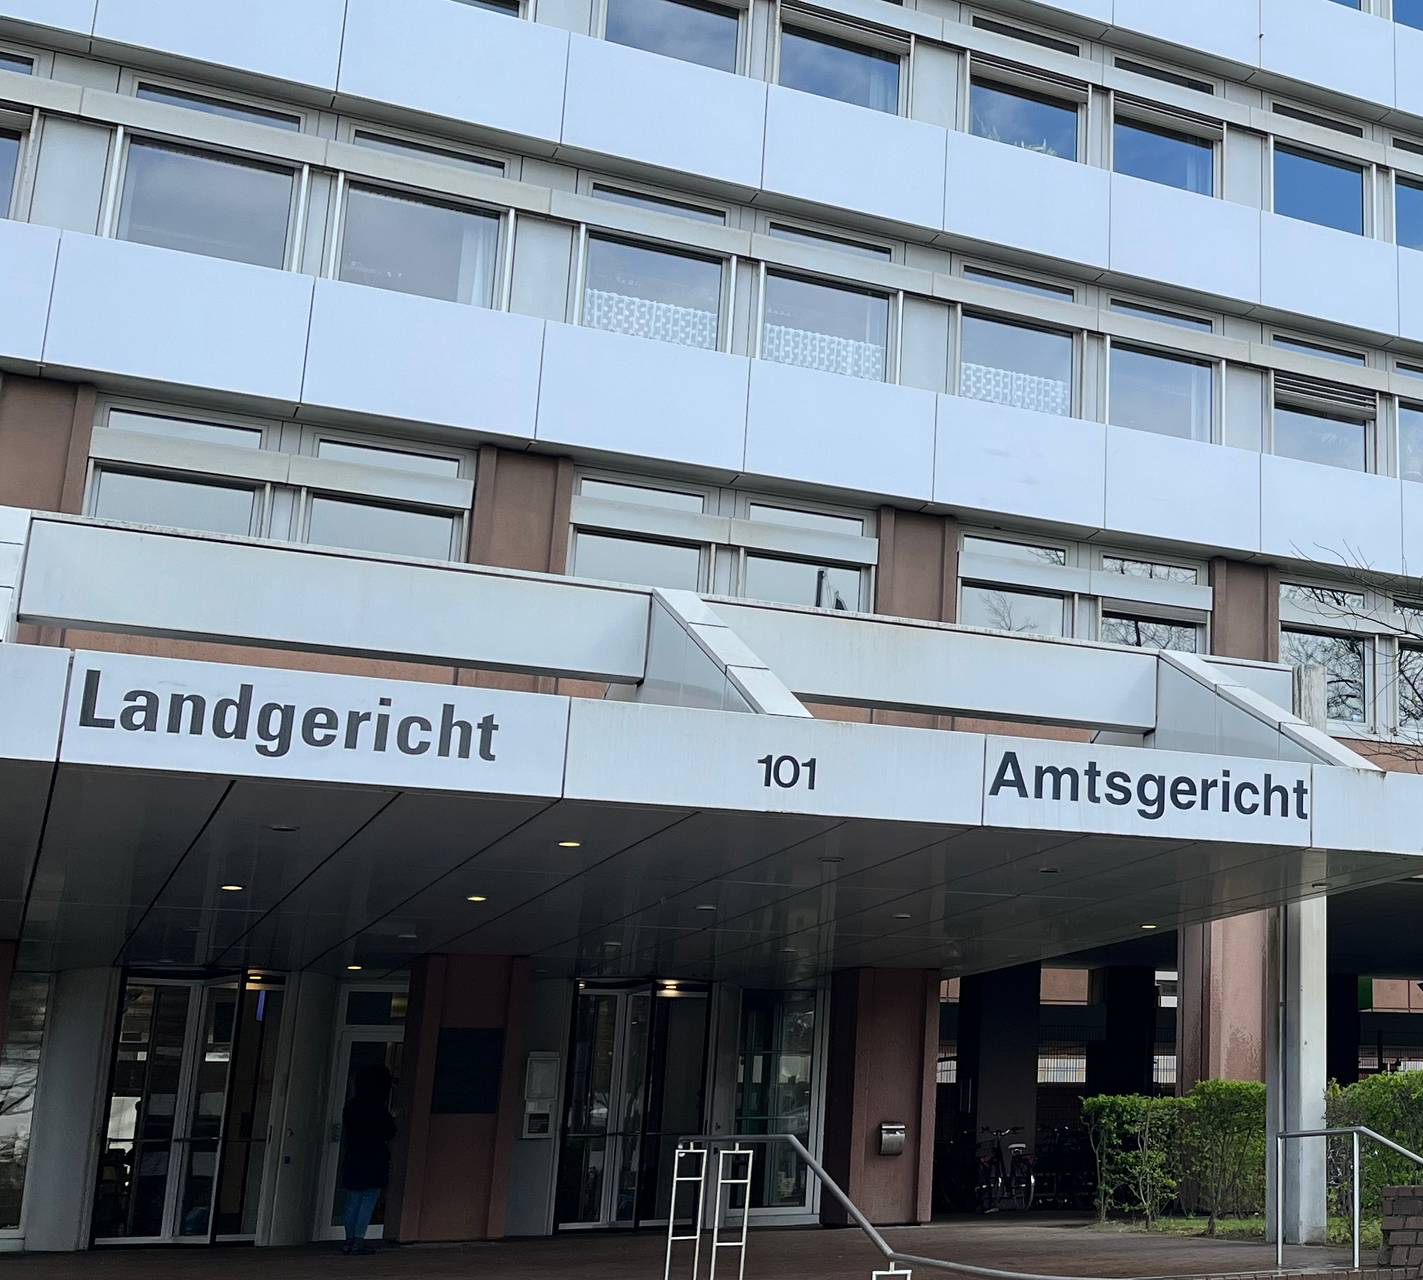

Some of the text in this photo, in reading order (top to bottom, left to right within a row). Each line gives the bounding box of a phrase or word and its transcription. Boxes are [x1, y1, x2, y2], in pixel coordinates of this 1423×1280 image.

[78, 669, 500, 762] Landgericht
[757, 754, 817, 791] 101
[988, 751, 1309, 820] Amtsgericht
